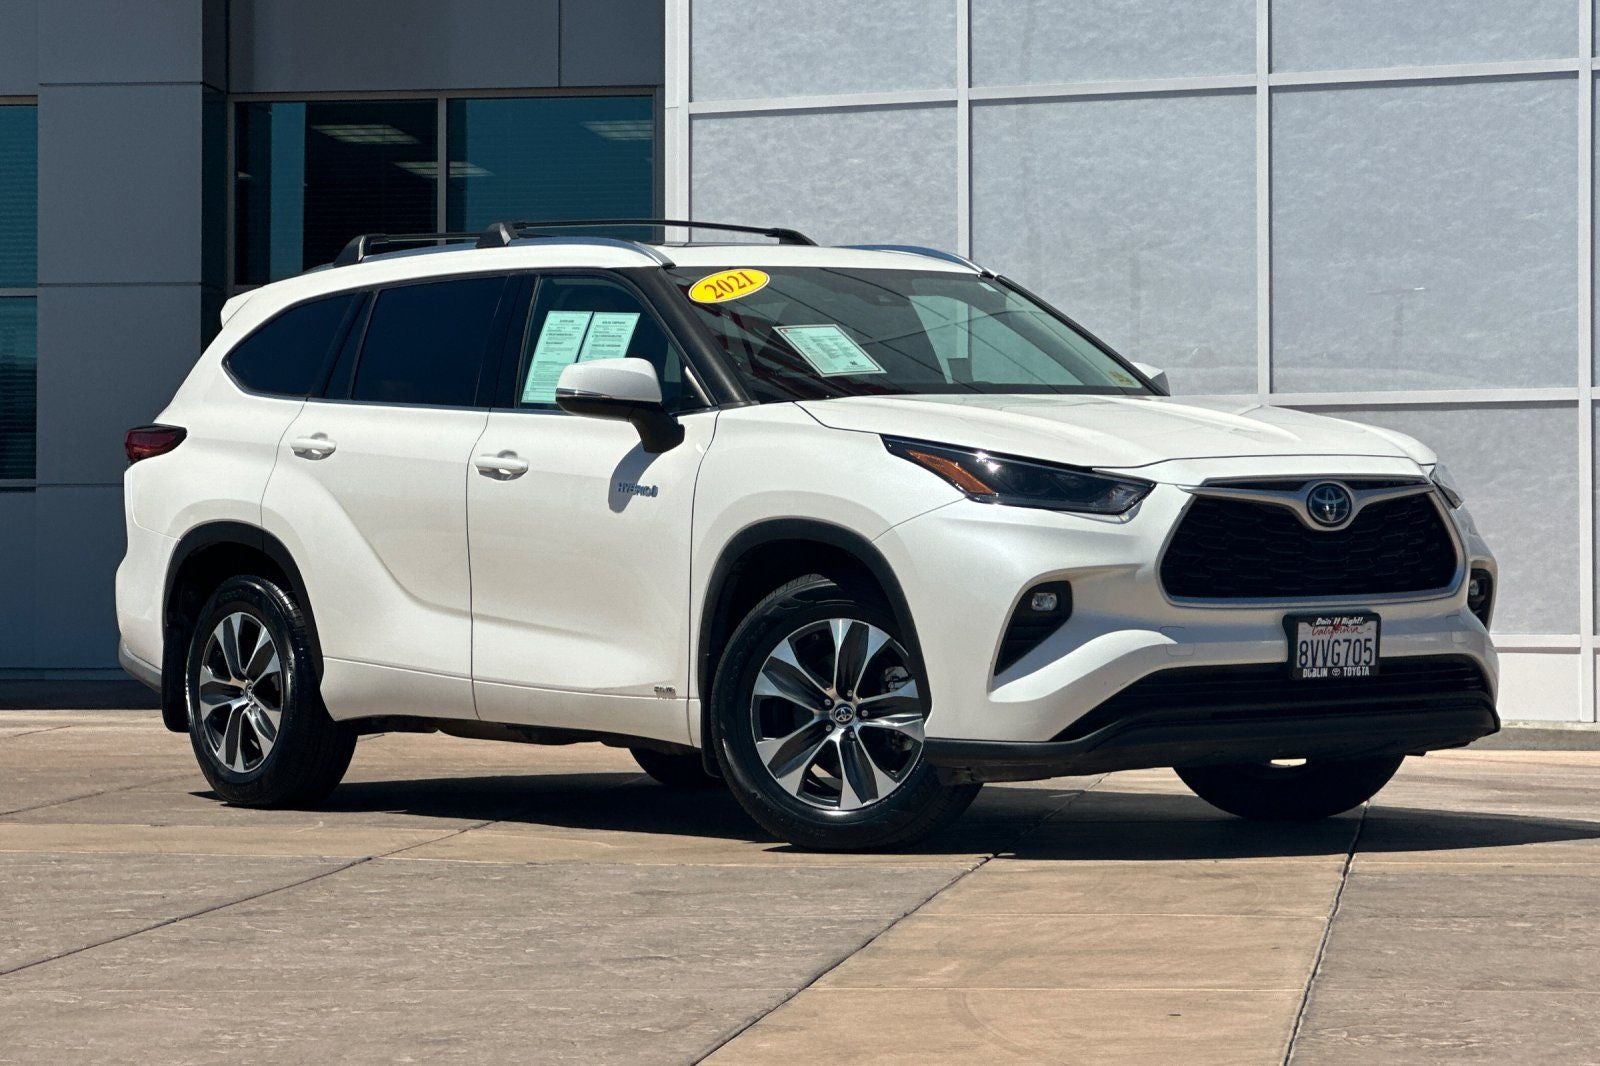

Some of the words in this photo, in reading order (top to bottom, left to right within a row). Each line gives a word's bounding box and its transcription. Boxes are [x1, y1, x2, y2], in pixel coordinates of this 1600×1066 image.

[704, 272, 756, 299] 2021
[1299, 638, 1373, 667] 8VVG705
[1343, 667, 1370, 677] TOYOTA
